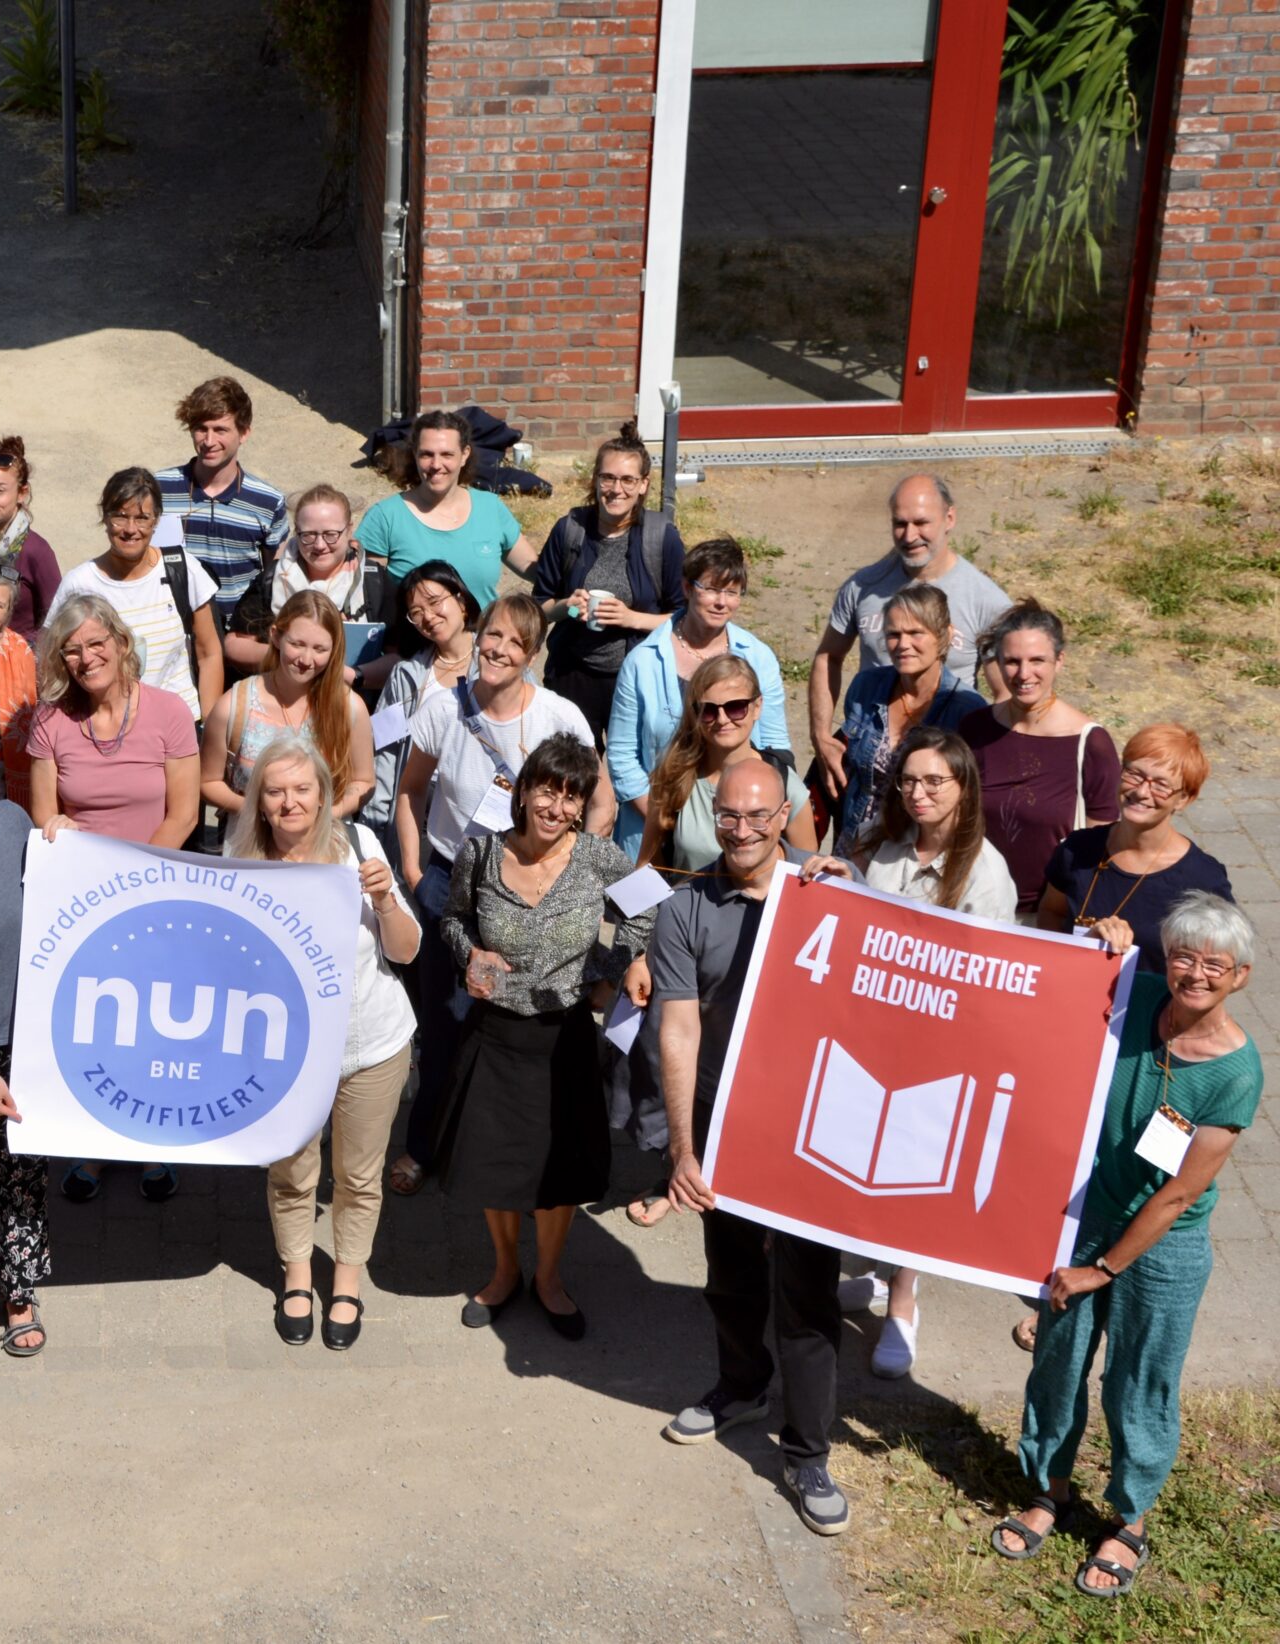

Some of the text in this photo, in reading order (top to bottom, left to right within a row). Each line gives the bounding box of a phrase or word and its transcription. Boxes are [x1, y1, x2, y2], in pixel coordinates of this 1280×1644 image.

[29, 861, 342, 1000] norddeutsch und nachhaltig
[793, 913, 840, 985] 4
[860, 925, 1042, 997] HOCHWERTIGE
[72, 976, 289, 1061] nun
[851, 964, 959, 1021] BILDUNG
[83, 1063, 265, 1127] ZERTIFIZIERT
[150, 1060, 203, 1081] BNE
